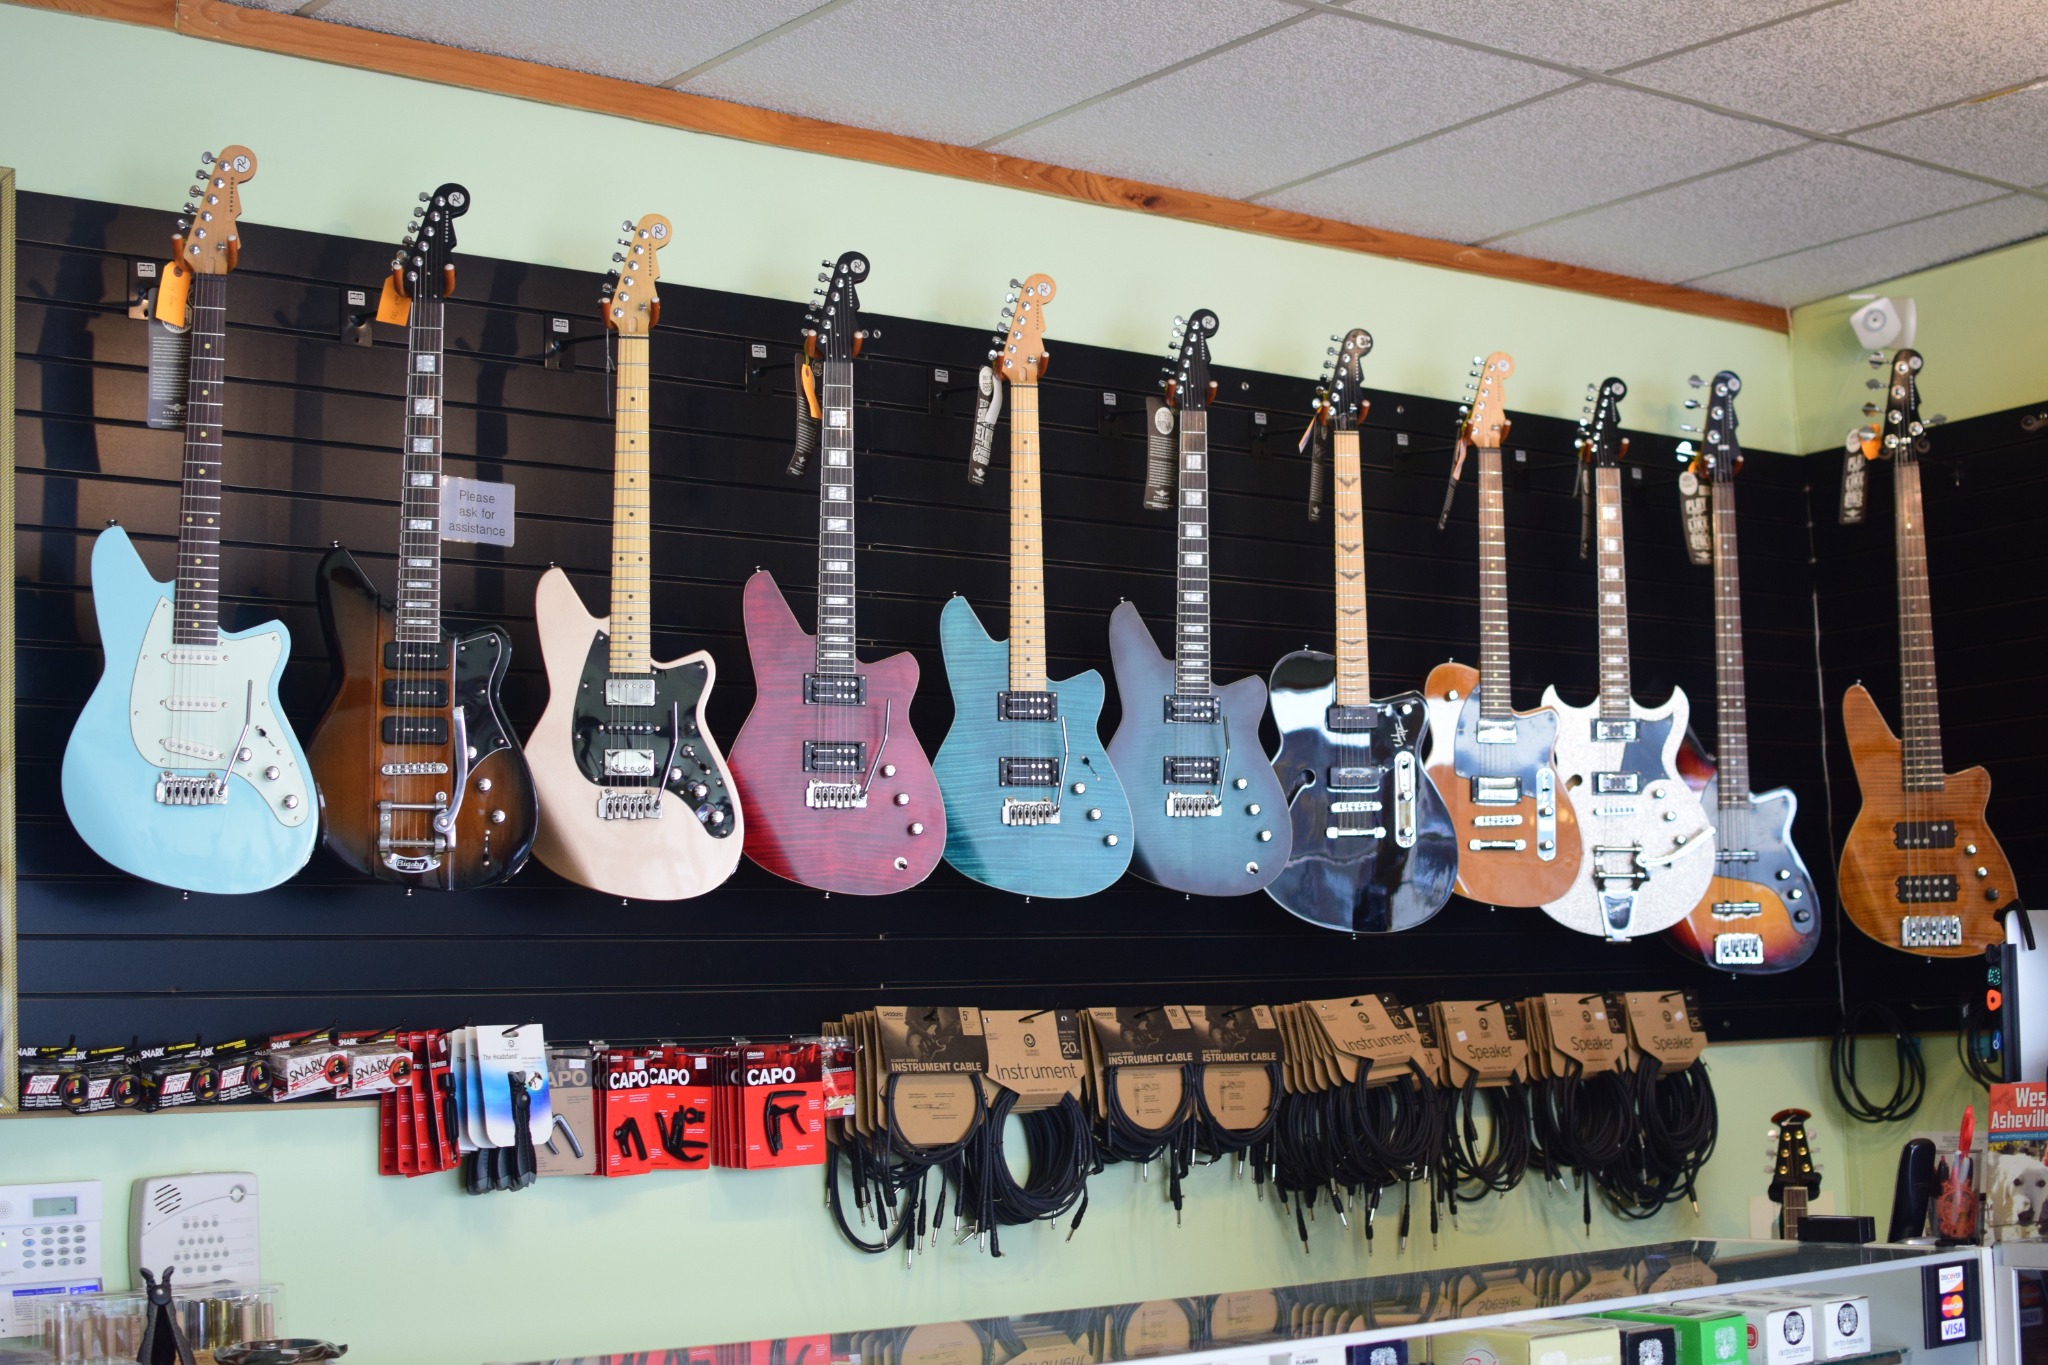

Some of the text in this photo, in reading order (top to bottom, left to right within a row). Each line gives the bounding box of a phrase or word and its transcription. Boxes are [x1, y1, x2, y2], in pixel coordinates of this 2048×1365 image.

[459, 489, 496, 504] Please
[459, 507, 496, 520] ask for
[448, 522, 506, 537] assistance
[1343, 1031, 1416, 1052] Instrument
[1571, 1035, 1613, 1051] Speaker
[1652, 1034, 1694, 1051] Speaker
[18, 1047, 38, 1057] NARK
[141, 1047, 165, 1059] SNARK
[1108, 1052, 1193, 1065] INSTRUMENT CABLE
[1251, 1051, 1277, 1061] CABLE
[1467, 1044, 1512, 1061] Speaker
[289, 1056, 325, 1082] SNARK
[355, 1056, 390, 1080] SNARK
[891, 1061, 982, 1072] INSTRUMENT CABLE
[995, 1062, 1078, 1080] Instrument
[221, 1073, 243, 1089] TIGHT
[548, 1070, 588, 1087] APO
[609, 1070, 649, 1090] CAPO
[649, 1068, 690, 1086] CAPO
[747, 1066, 796, 1086] CAPO
[27, 1082, 57, 1094] TIGHT
[163, 1081, 188, 1094] TIGHT
[1941, 1271, 1961, 1281] DISCOVER
[1944, 1322, 1964, 1336] VISA
